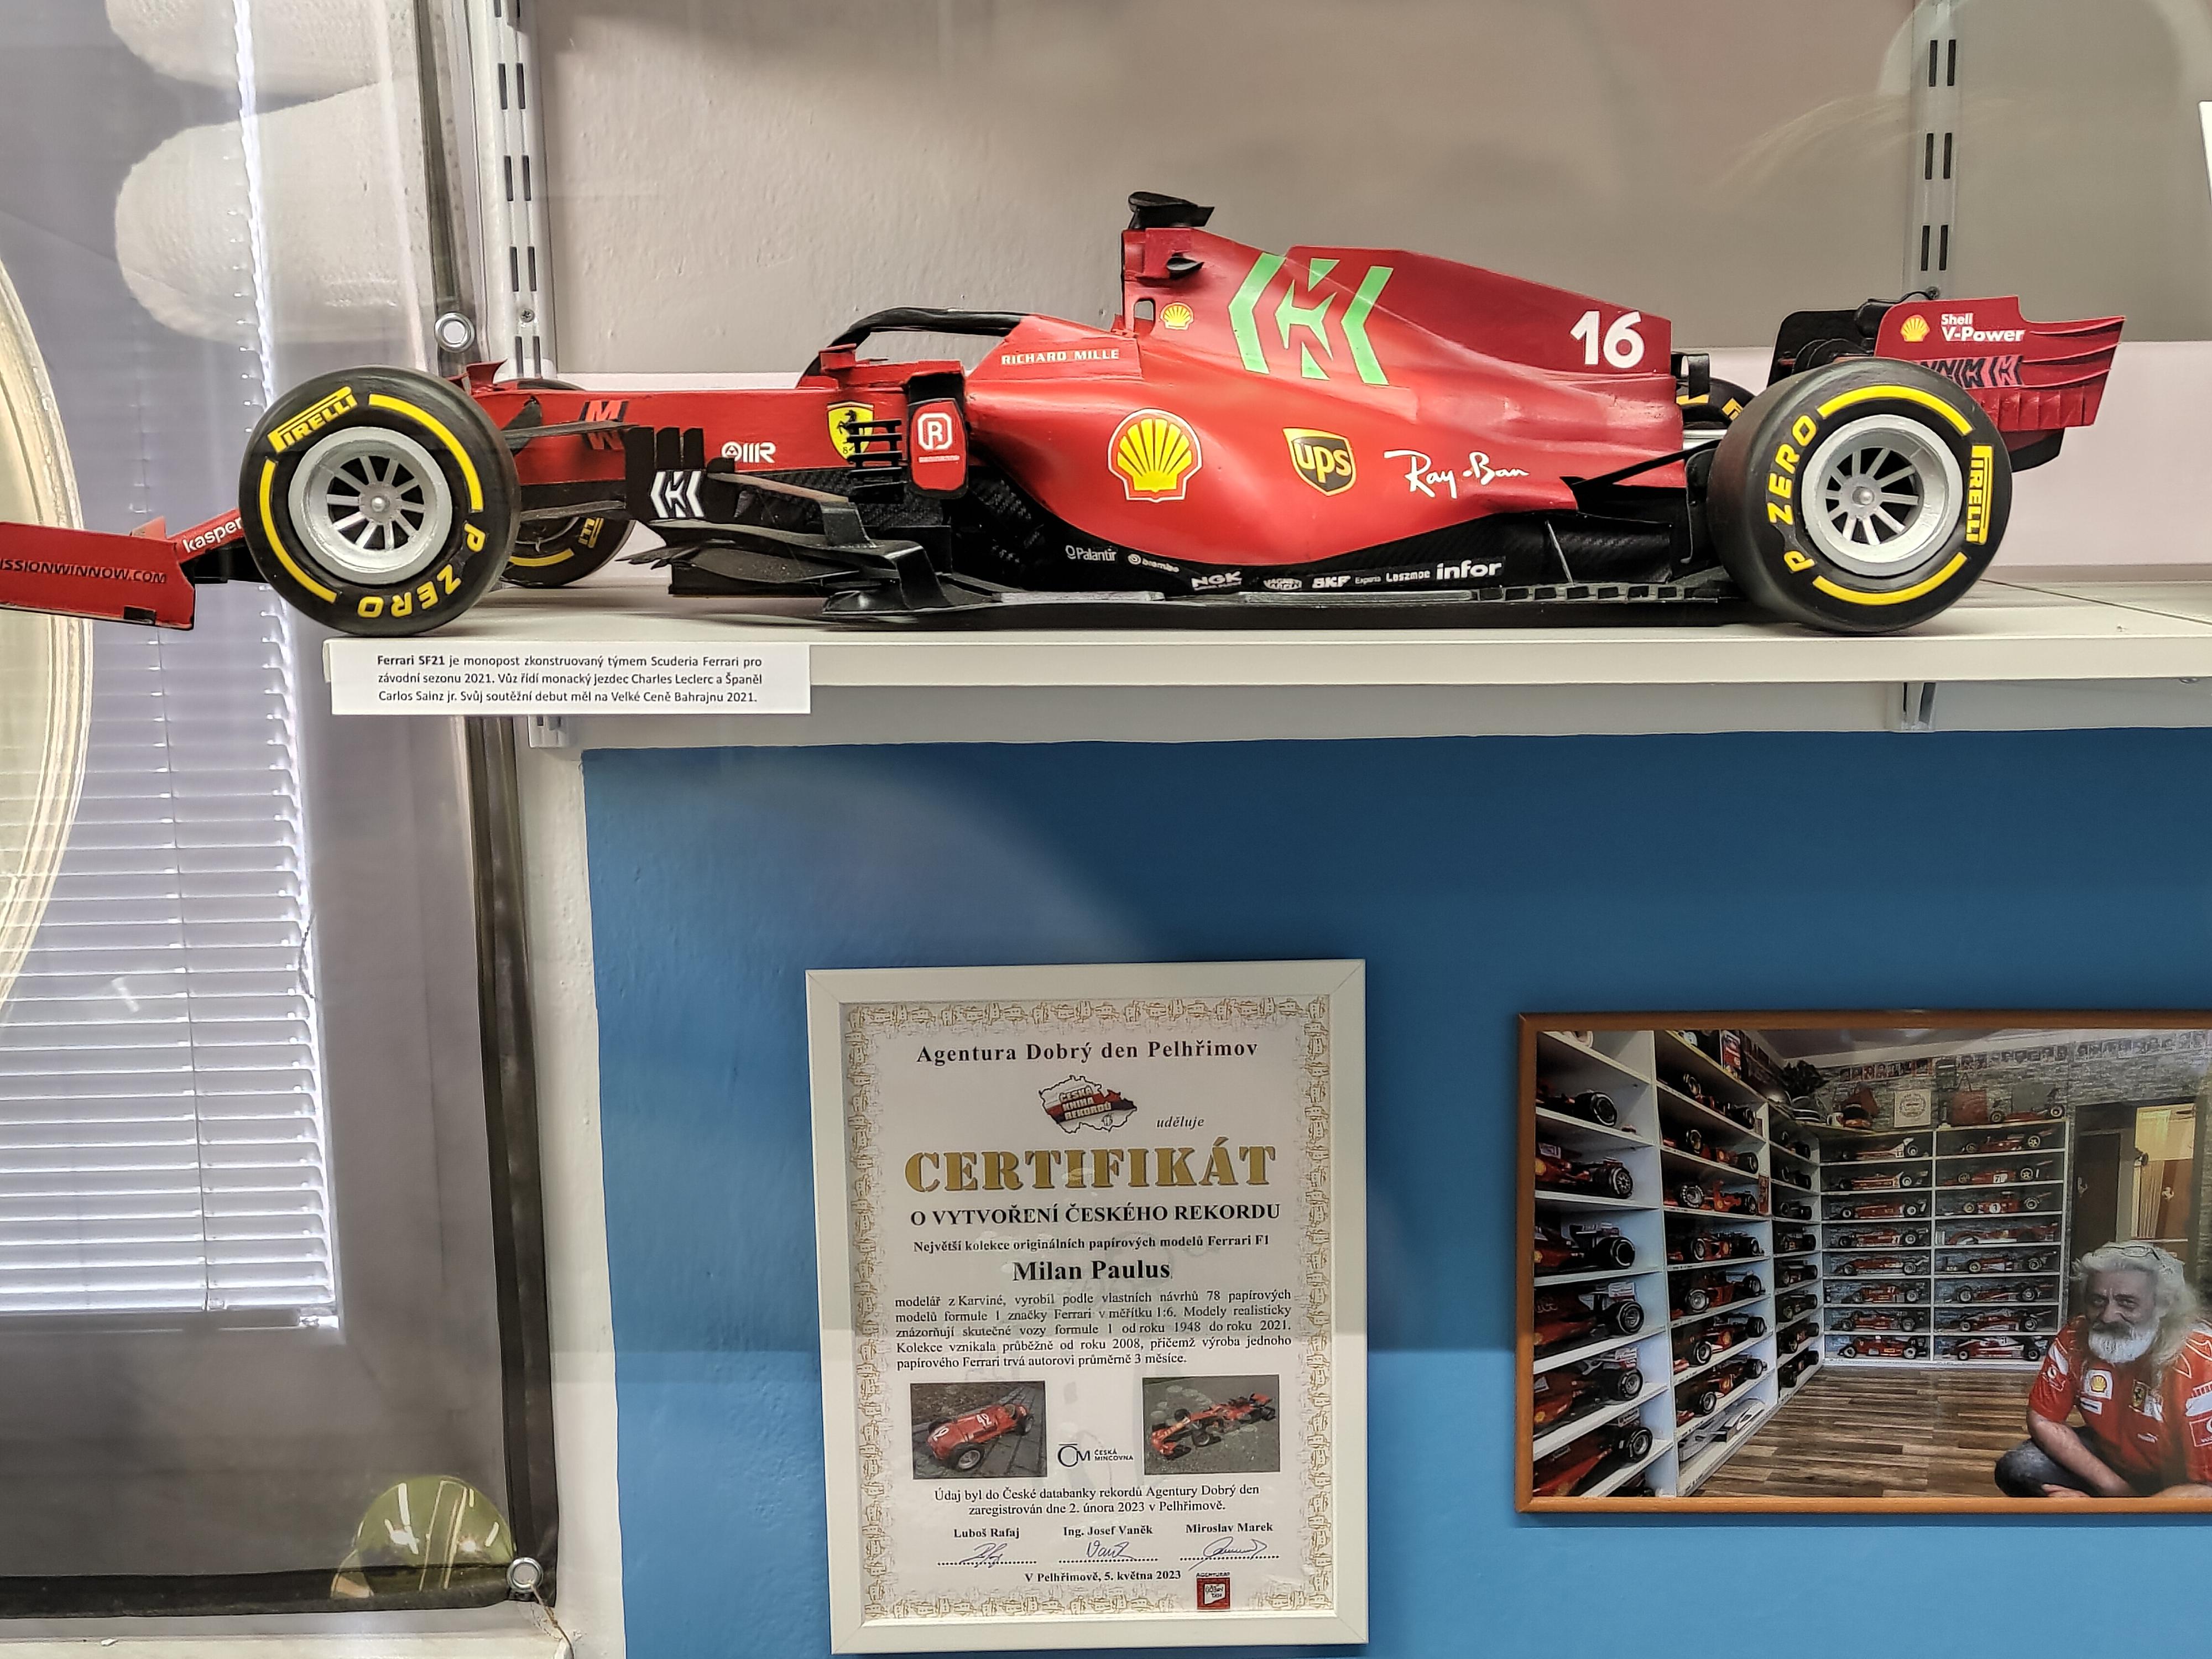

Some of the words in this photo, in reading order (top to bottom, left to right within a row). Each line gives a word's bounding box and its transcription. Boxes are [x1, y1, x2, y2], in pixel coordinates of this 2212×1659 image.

[1941, 313, 1974, 325] Shell
[1569, 310, 1645, 369] 16
[1942, 326, 2026, 342] V-Power
[1001, 351, 1067, 365] RICHARD
[1074, 348, 1120, 360] MILLE
[267, 386, 359, 453] PIRELLI
[1294, 444, 1352, 484] ups
[1767, 414, 1818, 526] ZERO
[1966, 445, 1992, 545] PIRELLI
[463, 524, 486, 552] P
[1076, 545, 1117, 561] Palantir
[1784, 549, 1817, 573] P
[1437, 560, 1503, 580] infor
[1191, 571, 1243, 588] NGK
[1312, 576, 1351, 588] SKF
[357, 565, 461, 619] ZERO
[378, 655, 414, 665] Ferrari
[419, 656, 445, 665] SF21
[449, 655, 459, 667] je
[464, 656, 520, 667] monopost
[525, 655, 603, 667] zkonstruovaný
[608, 656, 646, 668] týmem
[651, 656, 698, 666] Scuderia
[703, 657, 738, 666] Ferrari
[744, 659, 761, 669] pro
[378, 672, 420, 682] závodní
[465, 674, 494, 683] 2021.
[498, 673, 517, 683] Vůz
[521, 673, 539, 683] řídí
[542, 673, 591, 686] monacký
[593, 674, 628, 686] jezdec
[632, 674, 672, 684] Charles
[676, 674, 713, 684] Leclerc
[726, 672, 761, 686] Španěl
[379, 691, 413, 701] Carlos
[416, 691, 444, 701] Sainz
[447, 691, 457, 703] jr.
[461, 690, 482, 703] Svůj
[486, 691, 532, 701] soutěžní
[535, 691, 567, 701] debut
[571, 691, 591, 701] měl
[611, 691, 640, 701] Velké
[644, 692, 671, 701] Ceně
[675, 692, 723, 704] Bahrajnu
[727, 692, 757, 702] 2021.
[916, 1046, 1016, 1066] Agentura
[1026, 1042, 1092, 1063] Dobrý
[1102, 1042, 1137, 1058] den
[1148, 1040, 1257, 1057] Pelhřimov
[1157, 1116, 1204, 1130] uděluje
[905, 1136, 1276, 1193] CERTIFIKÁT
[911, 1211, 926, 1225] O
[932, 1203, 1058, 1225] VYTVOŘENÍ
[1066, 1202, 1167, 1222] ČESKÉHO
[1175, 1204, 1280, 1220] REKORDU
[914, 1240, 961, 1254] Největší
[966, 1240, 1009, 1250] kolekce
[1014, 1238, 1084, 1251] originálních
[1089, 1237, 1155, 1250] papírových
[1160, 1235, 1203, 1246] modelů
[1208, 1235, 1251, 1245] Ferrari
[1256, 1235, 1268, 1245] F1
[1013, 1261, 1082, 1281] Milan
[1092, 1260, 1170, 1279] Paulus
[895, 1296, 941, 1307] modelář
[959, 1295, 1006, 1307] Karviné,
[1015, 1293, 1054, 1307] vyrobil
[1063, 1293, 1093, 1306] podle
[1102, 1292, 1151, 1302] vlastních
[1160, 1291, 1198, 1301] návrhů
[1207, 1291, 1220, 1301] 78
[1229, 1289, 1291, 1303] papírových
[896, 1312, 937, 1322] modelů
[945, 1311, 987, 1321] formule
[1008, 1310, 1047, 1322] značky
[1055, 1309, 1091, 1319] Ferrari
[1109, 1307, 1152, 1318] měřítku
[1158, 1307, 1176, 1317] 1:6.
[1185, 1306, 1227, 1318] Modely
[1234, 1305, 1291, 1317] realisticky
[896, 1326, 954, 1339] znázorňují
[963, 1326, 1011, 1336] skutečné
[1019, 1328, 1046, 1337] vozy
[1055, 1324, 1098, 1334] formule
[1122, 1323, 1136, 1333] od
[1140, 1323, 1164, 1333] roku
[1175, 1322, 1201, 1332] 1948
[1209, 1321, 1223, 1331] do
[1227, 1321, 1252, 1331] roku
[1260, 1320, 1291, 1330] 2021.
[897, 1342, 942, 1353] Kolekce
[949, 1342, 995, 1352] vznikala
[1003, 1340, 1053, 1354] průběžně
[1060, 1340, 1073, 1349] od
[1081, 1339, 1105, 1349] roku
[1113, 1338, 1143, 1350] 2008,
[1151, 1336, 1195, 1350] přičemž
[1202, 1336, 1240, 1349] výroba
[1245, 1335, 1291, 1348] jednoho
[897, 1357, 959, 1371] papírového
[963, 1356, 999, 1366] Ferrari
[1004, 1356, 1025, 1366] trvá
[1029, 1355, 1074, 1365] autorovi
[1079, 1354, 1131, 1368] průměrně
[1135, 1354, 1141, 1364] 3
[1145, 1353, 1186, 1363] měsíce.
[935, 1488, 960, 1503] Údaj
[965, 1490, 982, 1503] byl
[986, 1490, 999, 1499] do
[1003, 1487, 1036, 1499] České
[1040, 1488, 1096, 1500] databanky
[1099, 1486, 1142, 1497] rekordů
[1146, 1486, 1197, 1499] Agentury
[1202, 1485, 1236, 1497] Dobrý
[1240, 1484, 1259, 1494] den
[969, 1504, 1042, 1517] zaregistrován
[1046, 1504, 1066, 1514] dne
[1070, 1504, 1079, 1513] 2.
[1083, 1503, 1114, 1512] února
[1118, 1502, 1144, 1512] 2023
[1160, 1500, 1225, 1511] Pelhřimově.
[954, 1528, 987, 1538] Luboš
[991, 1527, 1019, 1539] Rafaj
[1063, 1527, 1084, 1538] Ing.
[1087, 1526, 1116, 1535] Josef
[1119, 1525, 1153, 1535] Vaněk
[1186, 1524, 1233, 1533] Miroslav
[1238, 1522, 1273, 1532] Marek
[1025, 1573, 1033, 1582] V
[1037, 1572, 1101, 1582] Pelhřimově,
[1104, 1572, 1113, 1580] 5.
[1118, 1571, 1152, 1580] května
[1156, 1571, 1181, 1579] 2023
